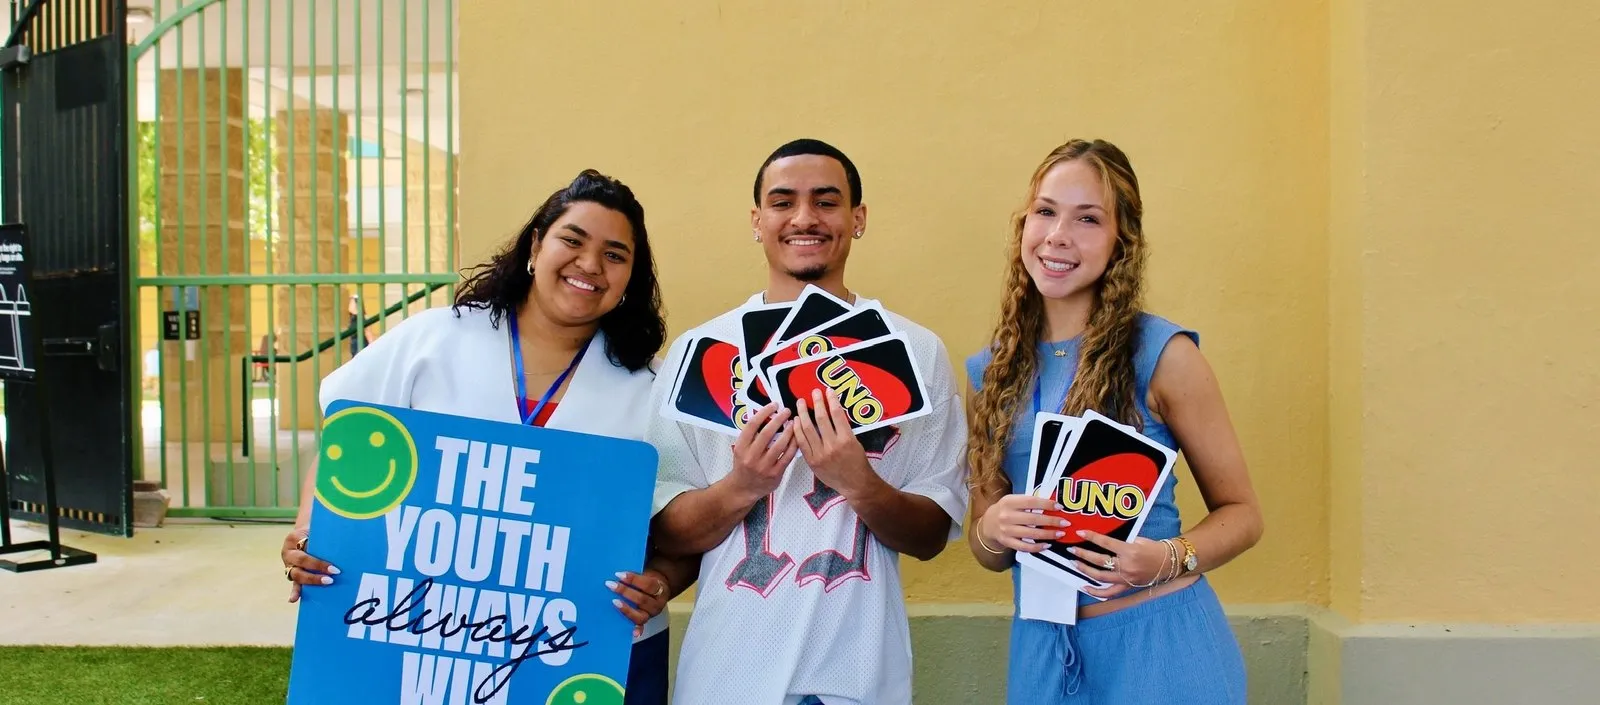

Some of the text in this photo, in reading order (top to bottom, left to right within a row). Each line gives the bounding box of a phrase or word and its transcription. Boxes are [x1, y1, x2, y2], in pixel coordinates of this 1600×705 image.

[816, 354, 884, 425] UNO
[435, 435, 541, 516] THE
[1057, 477, 1146, 520] UNO
[385, 504, 571, 593] YOUTH
[343, 577, 589, 704] always
[347, 572, 578, 667] ALWAYS
[401, 651, 512, 705] WIN
